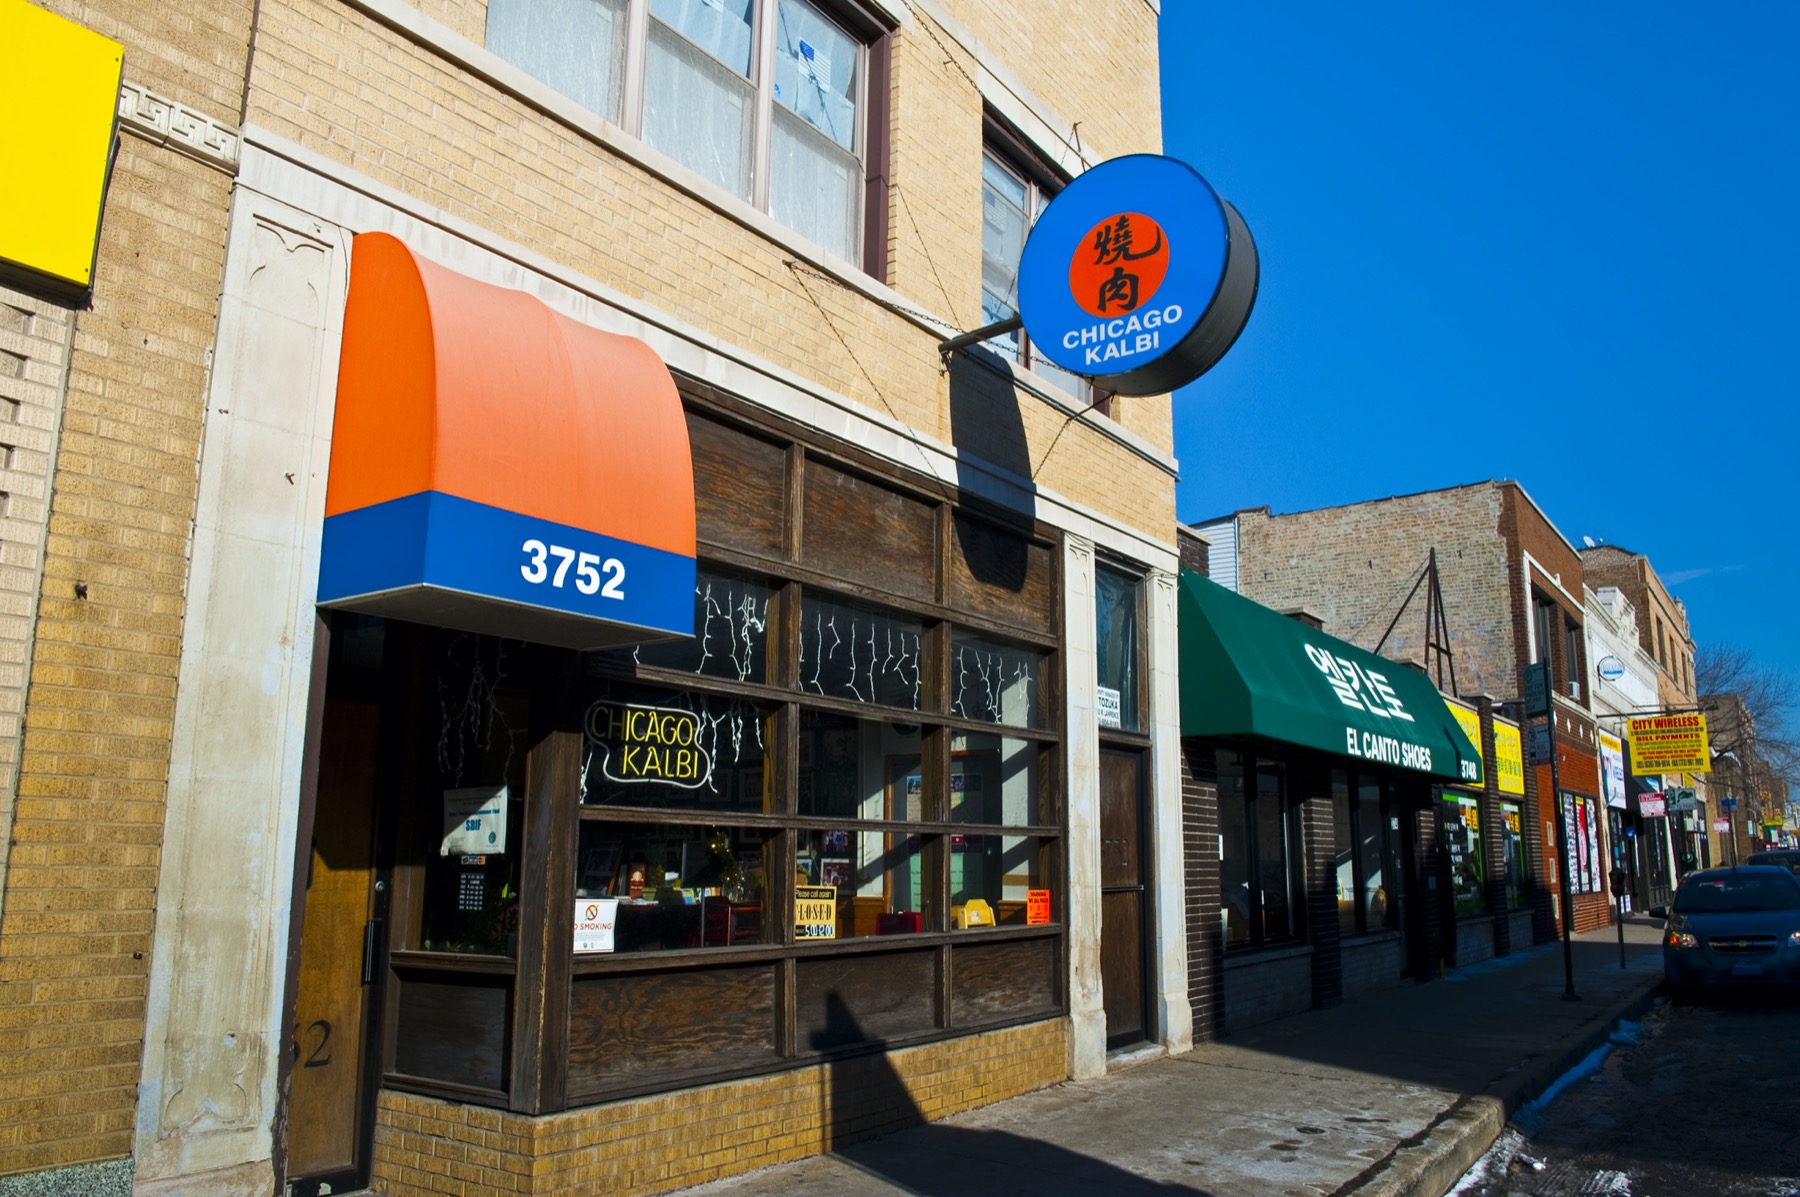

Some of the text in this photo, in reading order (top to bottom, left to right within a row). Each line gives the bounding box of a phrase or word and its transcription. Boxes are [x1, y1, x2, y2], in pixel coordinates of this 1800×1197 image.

[1093, 215, 1162, 313] 燒肉
[1062, 304, 1183, 349] CHICAGO
[1085, 331, 1160, 366] KALBI
[520, 539, 626, 601] 3752
[1304, 643, 1416, 723] 엘칸토
[1098, 696, 1118, 710] TOZUKA
[591, 706, 693, 746] CHICAGO
[1632, 716, 1699, 730] CITY WIRELESS
[1655, 733, 1701, 741] PAYMENTS
[623, 745, 698, 778] KALBI
[1346, 726, 1432, 772] EL CANTO SHOES
[465, 819, 482, 831] SBIF
[810, 890, 818, 898] call
[819, 891, 831, 899] again
[580, 922, 612, 931] SMOKING
